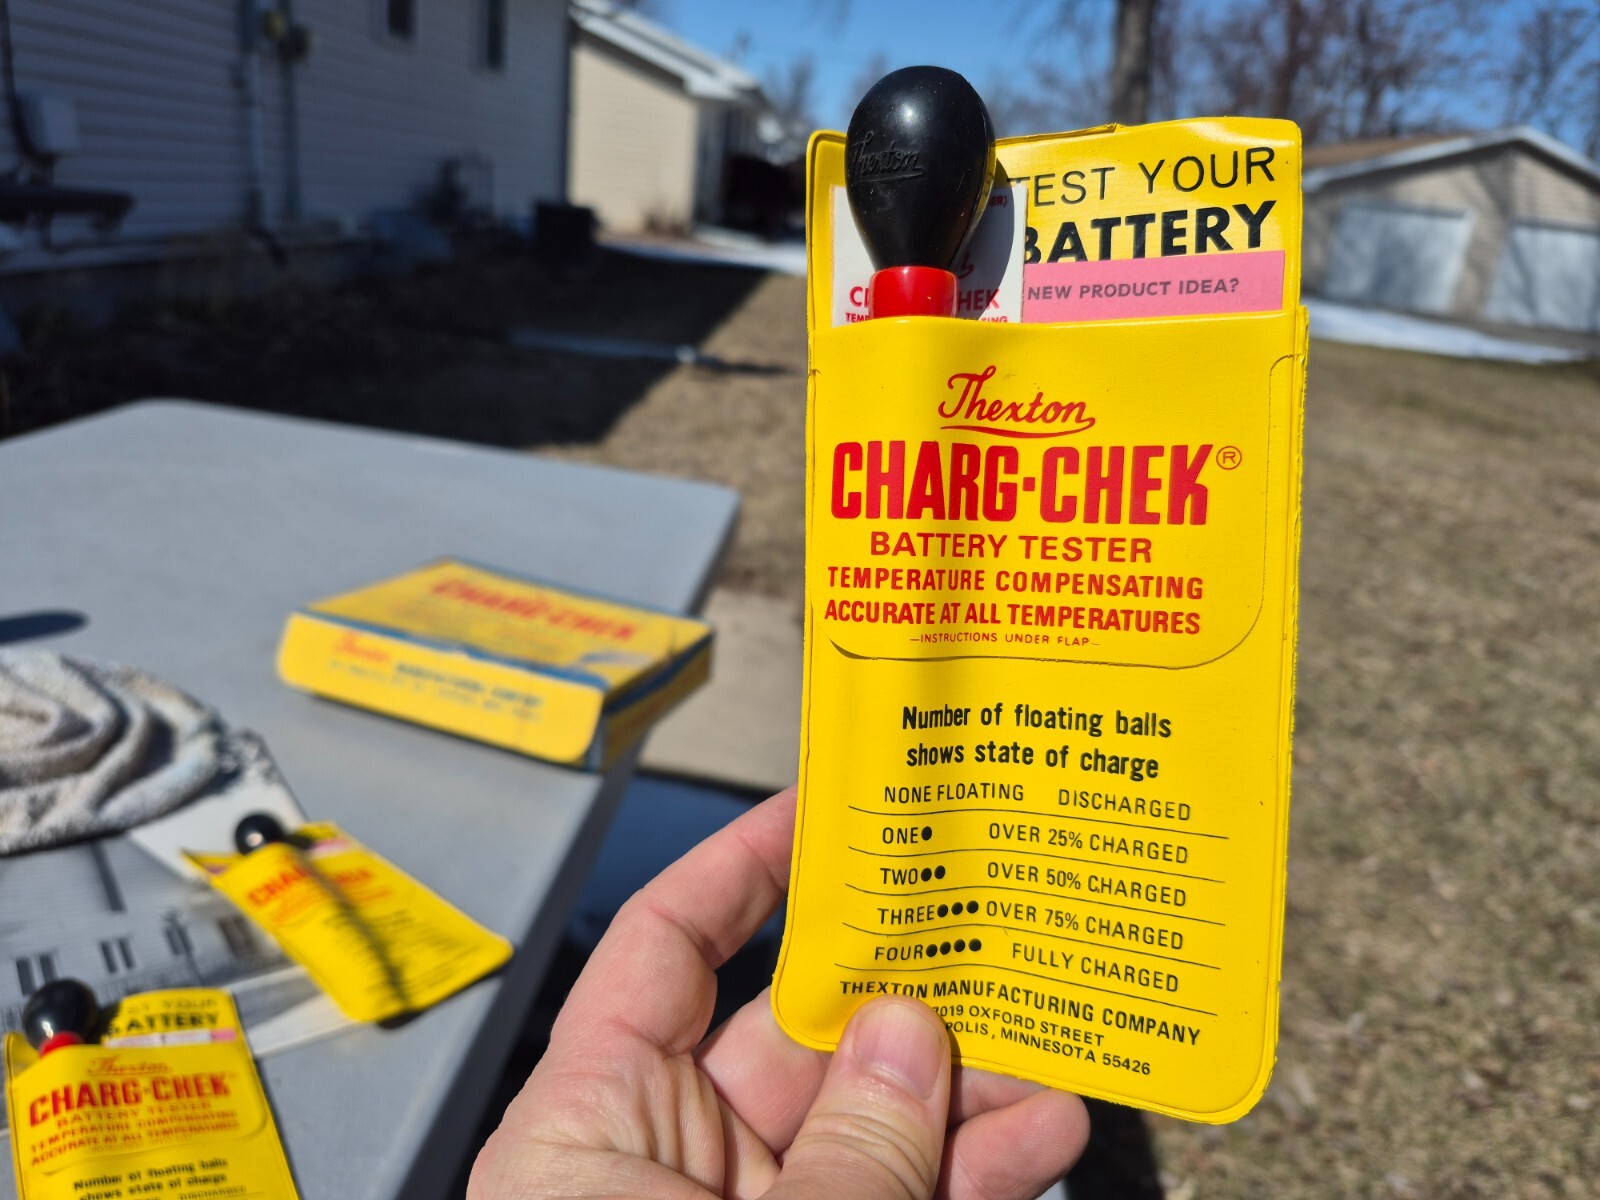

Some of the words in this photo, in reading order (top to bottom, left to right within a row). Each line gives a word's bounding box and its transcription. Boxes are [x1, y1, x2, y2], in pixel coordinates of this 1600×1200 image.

[1138, 146, 1276, 194] YOUR
[1024, 200, 1277, 264] BATTERY
[1028, 285, 1072, 300] NEW
[1079, 281, 1171, 299] PRODUCT
[1178, 278, 1239, 295] IDEA?
[938, 365, 1096, 431] Thexton
[870, 530, 1007, 558] BATTERY
[1019, 535, 1152, 563] TESTER
[828, 566, 985, 591] TEMPERATURE
[996, 570, 1203, 599] COMPENSATING
[825, 599, 936, 624] ACCURATE
[940, 602, 961, 624] AT
[964, 603, 1001, 624] ALL
[1008, 604, 1200, 634] TEMPERATURES
[1005, 633, 1049, 645] UNDER
[902, 704, 971, 730] Number
[981, 703, 1002, 726] of
[1014, 704, 1103, 738] floating
[1116, 710, 1172, 738] balls
[906, 741, 964, 767] shows
[974, 741, 1034, 765] state
[1045, 745, 1069, 768] of
[1080, 748, 1159, 782] charge
[884, 786, 932, 804] NONE
[937, 783, 1024, 801] FLOATING
[1058, 789, 1191, 821] DISCHARGED
[882, 827, 919, 844] ONE
[988, 823, 1040, 843] OVER
[1048, 828, 1083, 849] 25%
[1089, 834, 1188, 864] CHARGED
[880, 867, 918, 885] TWO
[987, 862, 1039, 883] OVER
[1046, 869, 1081, 890] 50%
[1087, 876, 1186, 907] CHARGED
[877, 904, 935, 925] THREE
[986, 900, 1037, 923] OVER
[1044, 909, 1079, 931] 75%
[1086, 916, 1183, 950] CHARGED
[875, 944, 923, 961] FOUR
[1012, 942, 1074, 969] FULLY
[1080, 956, 1179, 993] CHARGED
[110, 1011, 218, 1034] ATTERY
[840, 981, 928, 998] THEXTON
[933, 980, 1094, 1022] MANUFACTURING
[1102, 1008, 1201, 1045] COMPANY
[969, 1005, 1035, 1029] OXFORD
[1040, 1022, 1104, 1046] STREET
[1001, 1027, 1096, 1062] MINNESOTA
[1103, 1053, 1150, 1075] 55426
